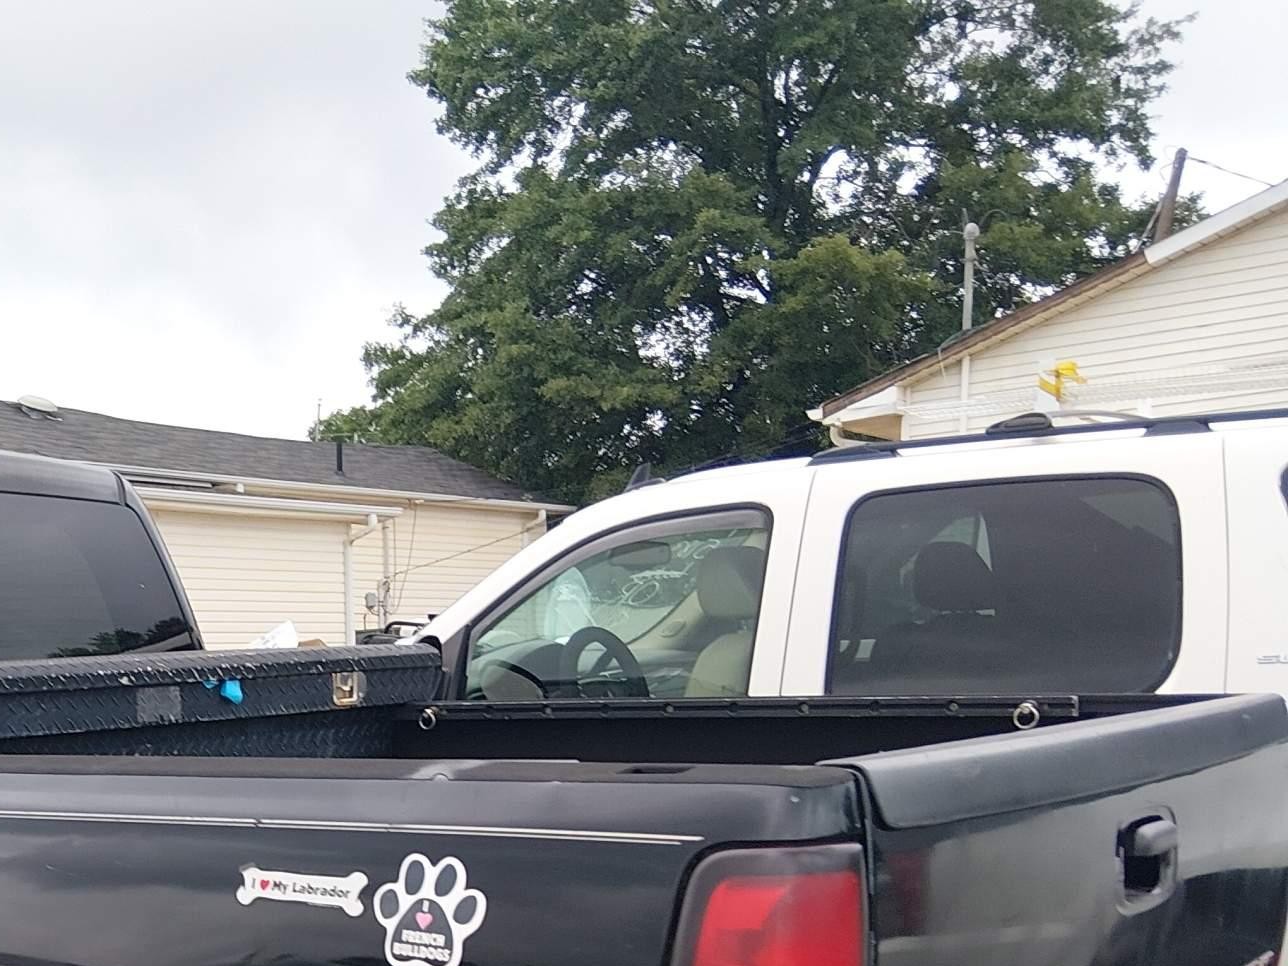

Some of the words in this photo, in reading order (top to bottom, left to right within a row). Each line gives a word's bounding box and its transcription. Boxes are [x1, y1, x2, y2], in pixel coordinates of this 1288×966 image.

[251, 878, 257, 889] I
[271, 880, 289, 894] My
[292, 881, 351, 898] Labrador
[401, 930, 446, 947] FRENCH
